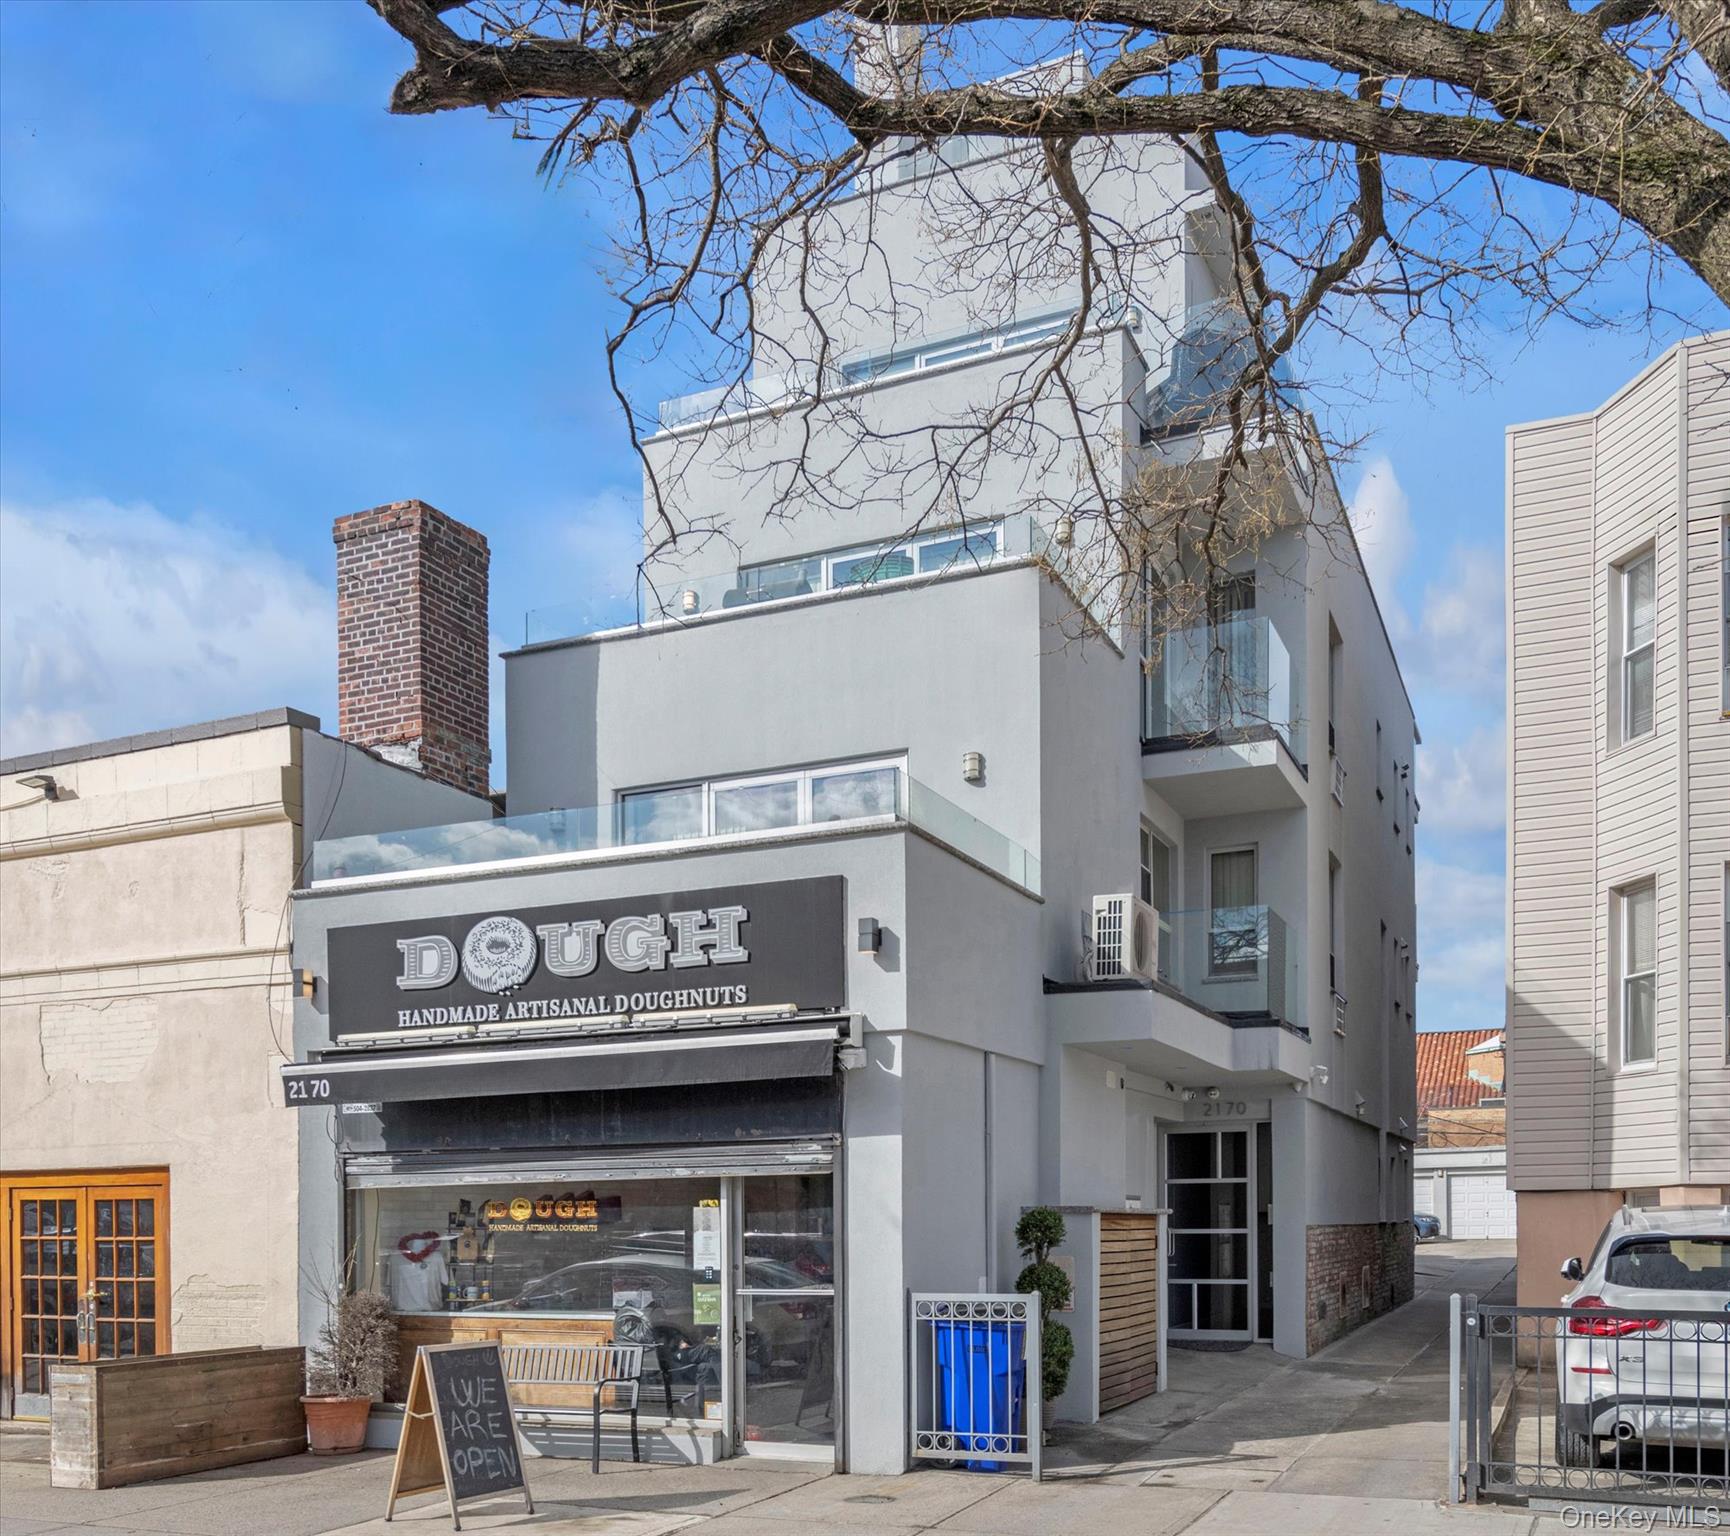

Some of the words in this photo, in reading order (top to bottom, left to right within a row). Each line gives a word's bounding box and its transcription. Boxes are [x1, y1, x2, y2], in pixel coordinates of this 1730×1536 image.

[396, 905, 749, 994] DOUGH
[398, 1003, 500, 1028] HANDMADE
[505, 996, 611, 1020] ARTISANAL
[614, 984, 748, 1013] DOUGHNUTS
[1203, 1102, 1247, 1117] 2170
[487, 1196, 599, 1222] DOUGH
[488, 1224, 524, 1232] HANDMADE
[526, 1224, 559, 1232] ARTISANAL
[559, 1224, 598, 1232] DOUGHNUTS
[450, 1376, 497, 1408] WE
[451, 1409, 507, 1440] ARE
[453, 1446, 517, 1479] OPEN
